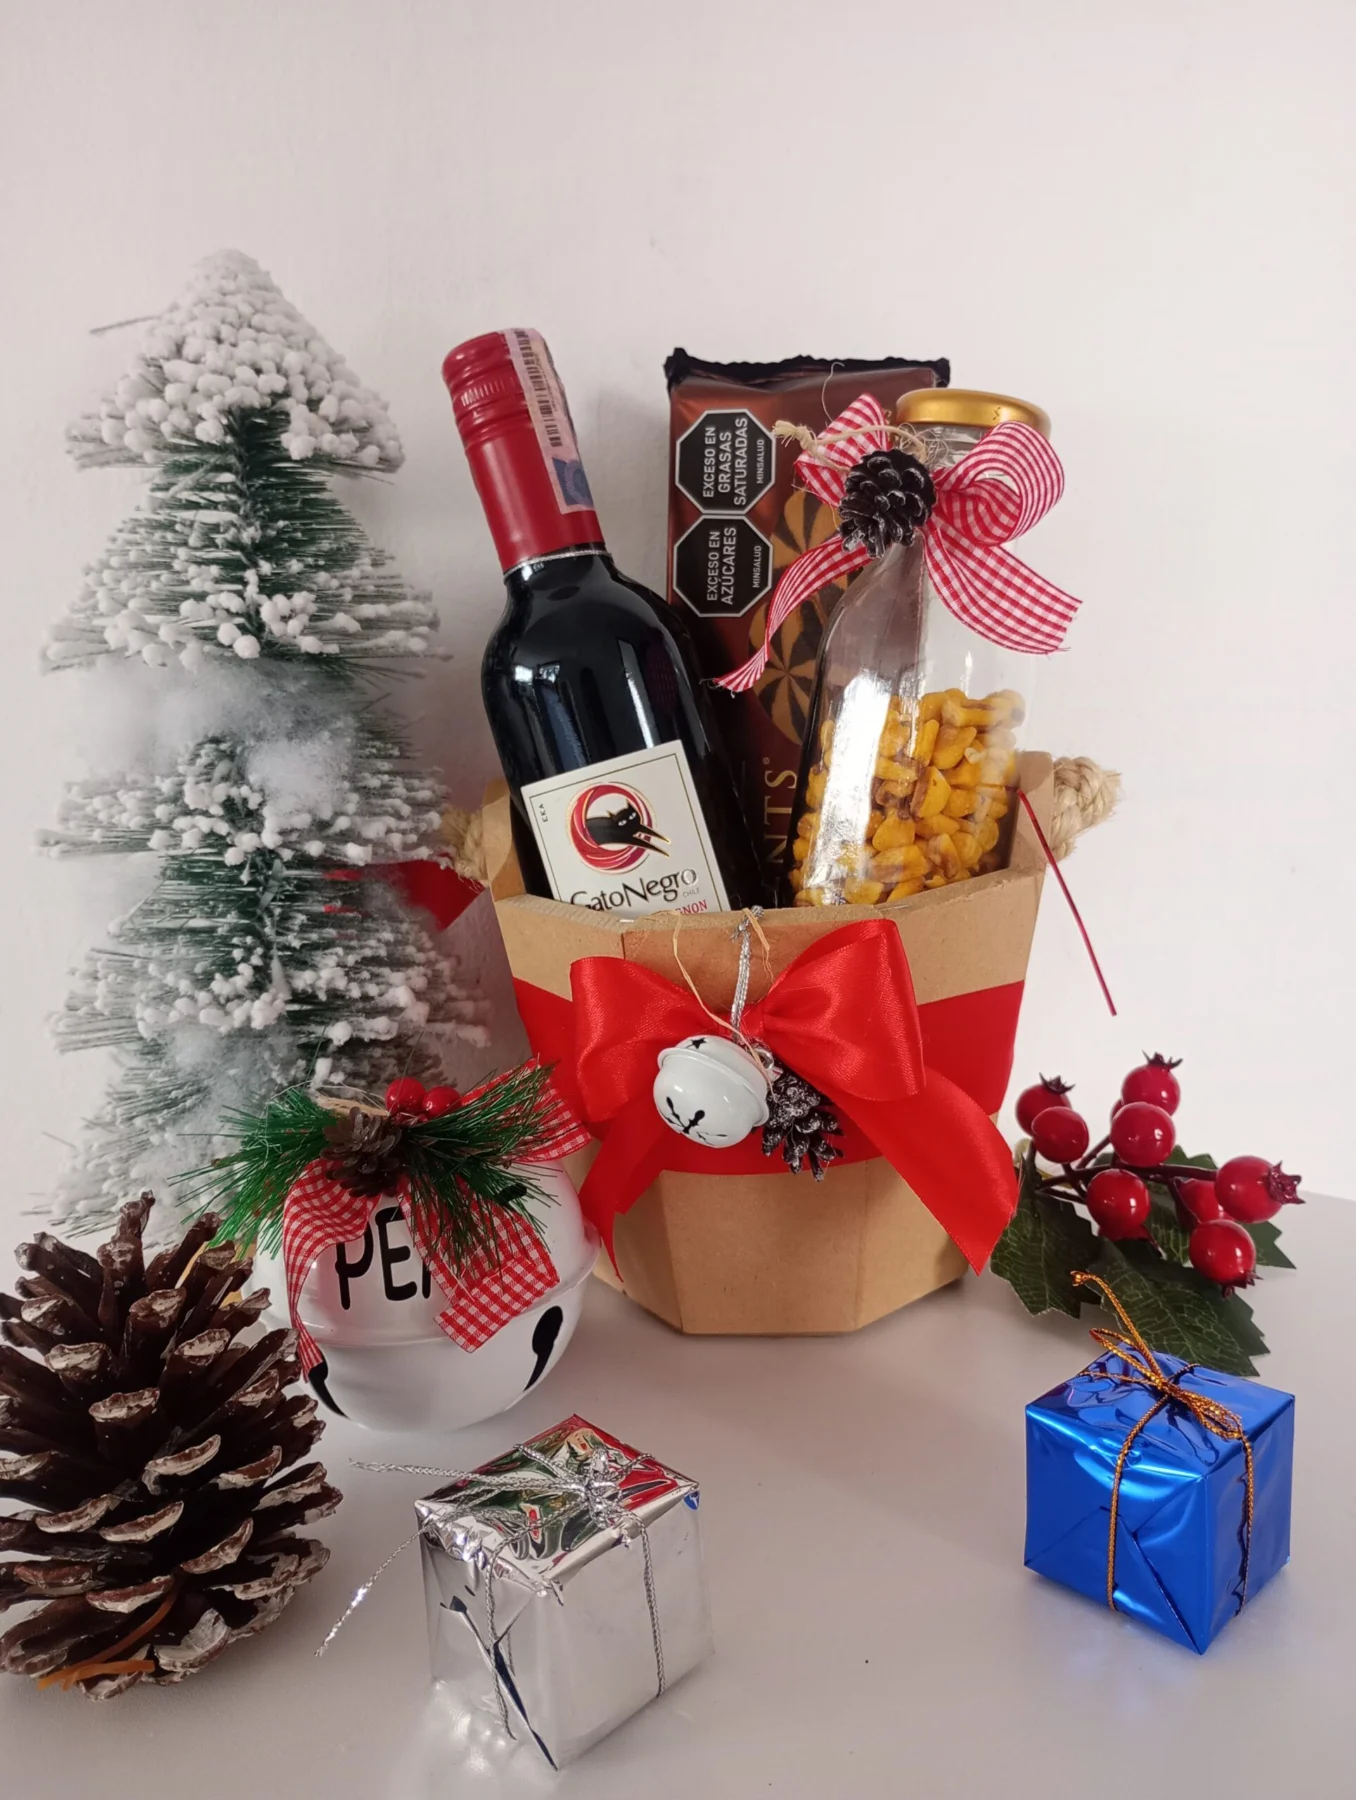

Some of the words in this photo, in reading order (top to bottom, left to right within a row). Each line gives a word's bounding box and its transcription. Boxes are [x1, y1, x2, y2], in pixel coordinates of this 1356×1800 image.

[705, 426, 716, 445] EN
[703, 448, 716, 498] EXCESO
[718, 430, 733, 493] GRASAS
[734, 417, 748, 506] SATURADAS
[756, 438, 765, 484] MINSALUD
[709, 531, 720, 549] EN
[707, 551, 720, 601] EXCESO
[714, 527, 738, 605] AZÚCARES
[752, 545, 762, 588] MINSALUD
[682, 887, 700, 897] CHILE
